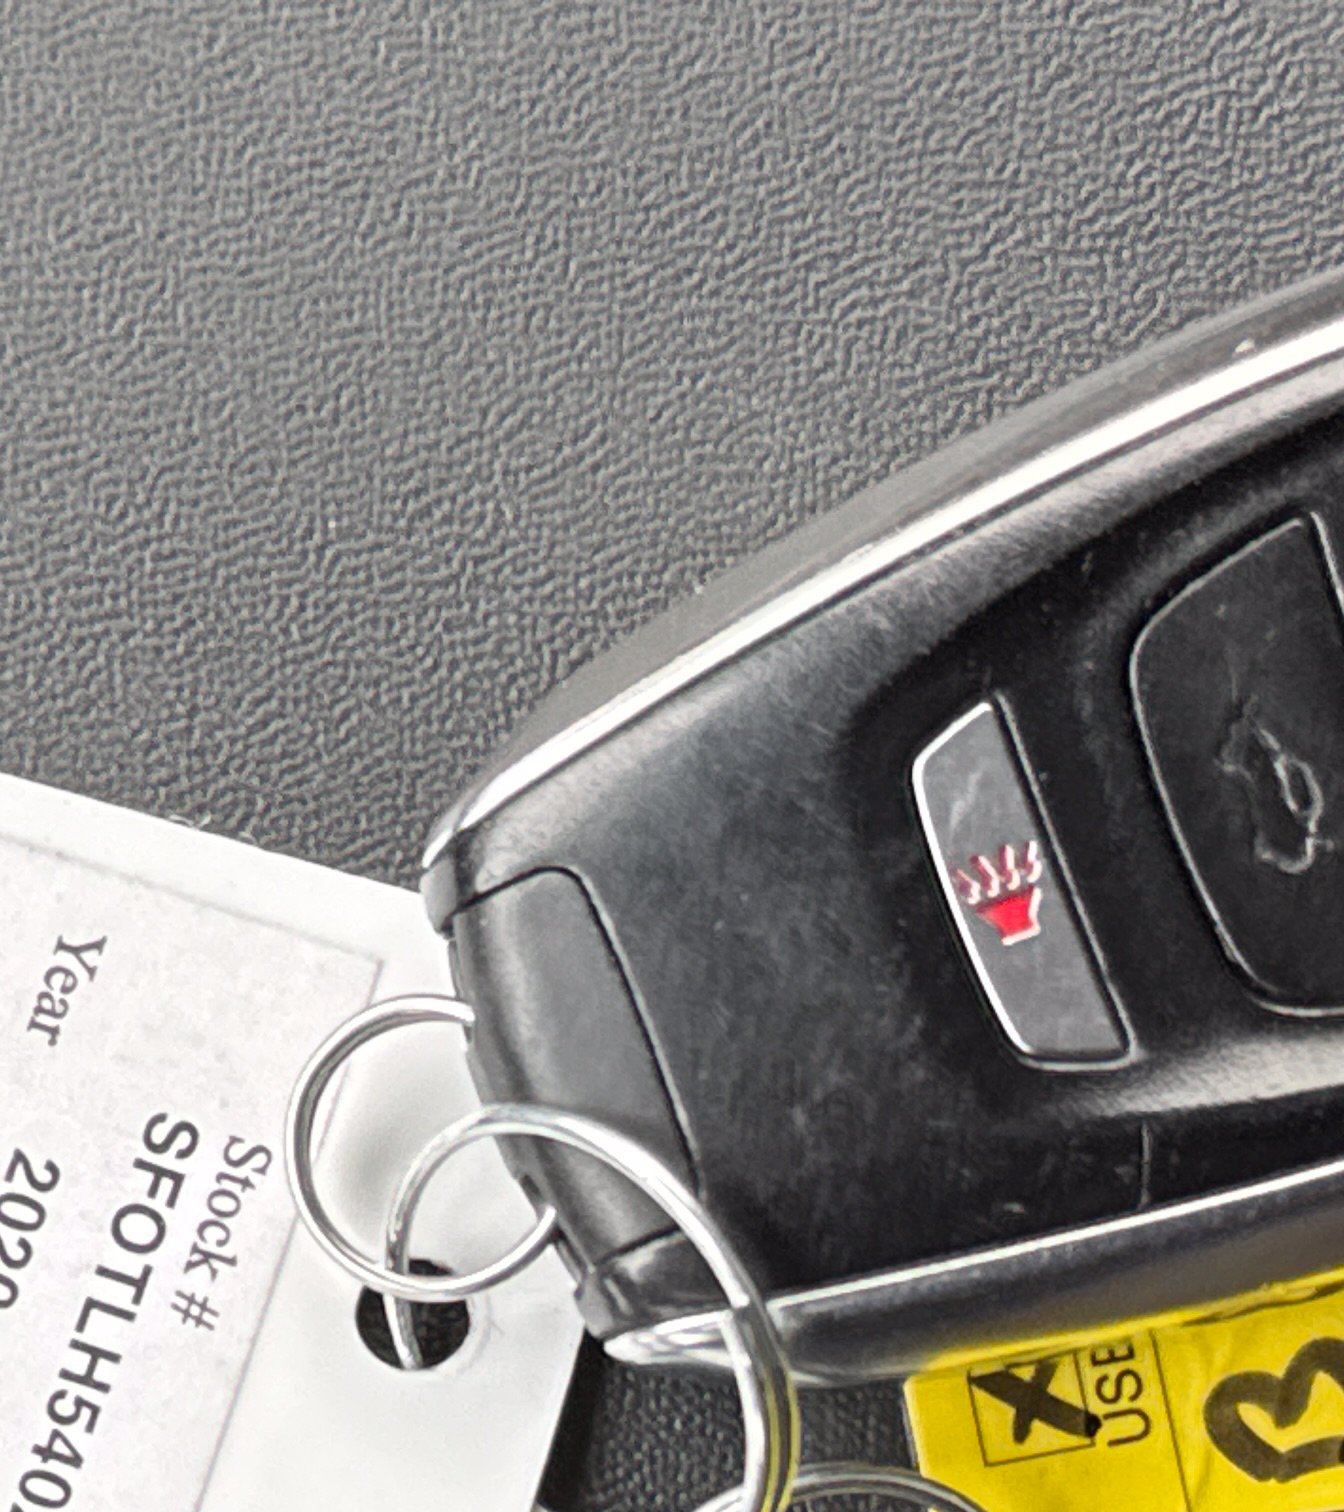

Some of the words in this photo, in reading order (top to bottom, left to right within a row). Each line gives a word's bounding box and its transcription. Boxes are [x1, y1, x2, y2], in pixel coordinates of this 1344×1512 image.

[27, 935, 108, 1047] Year
[185, 1135, 273, 1283] Stock
[171, 1290, 220, 1331] #
